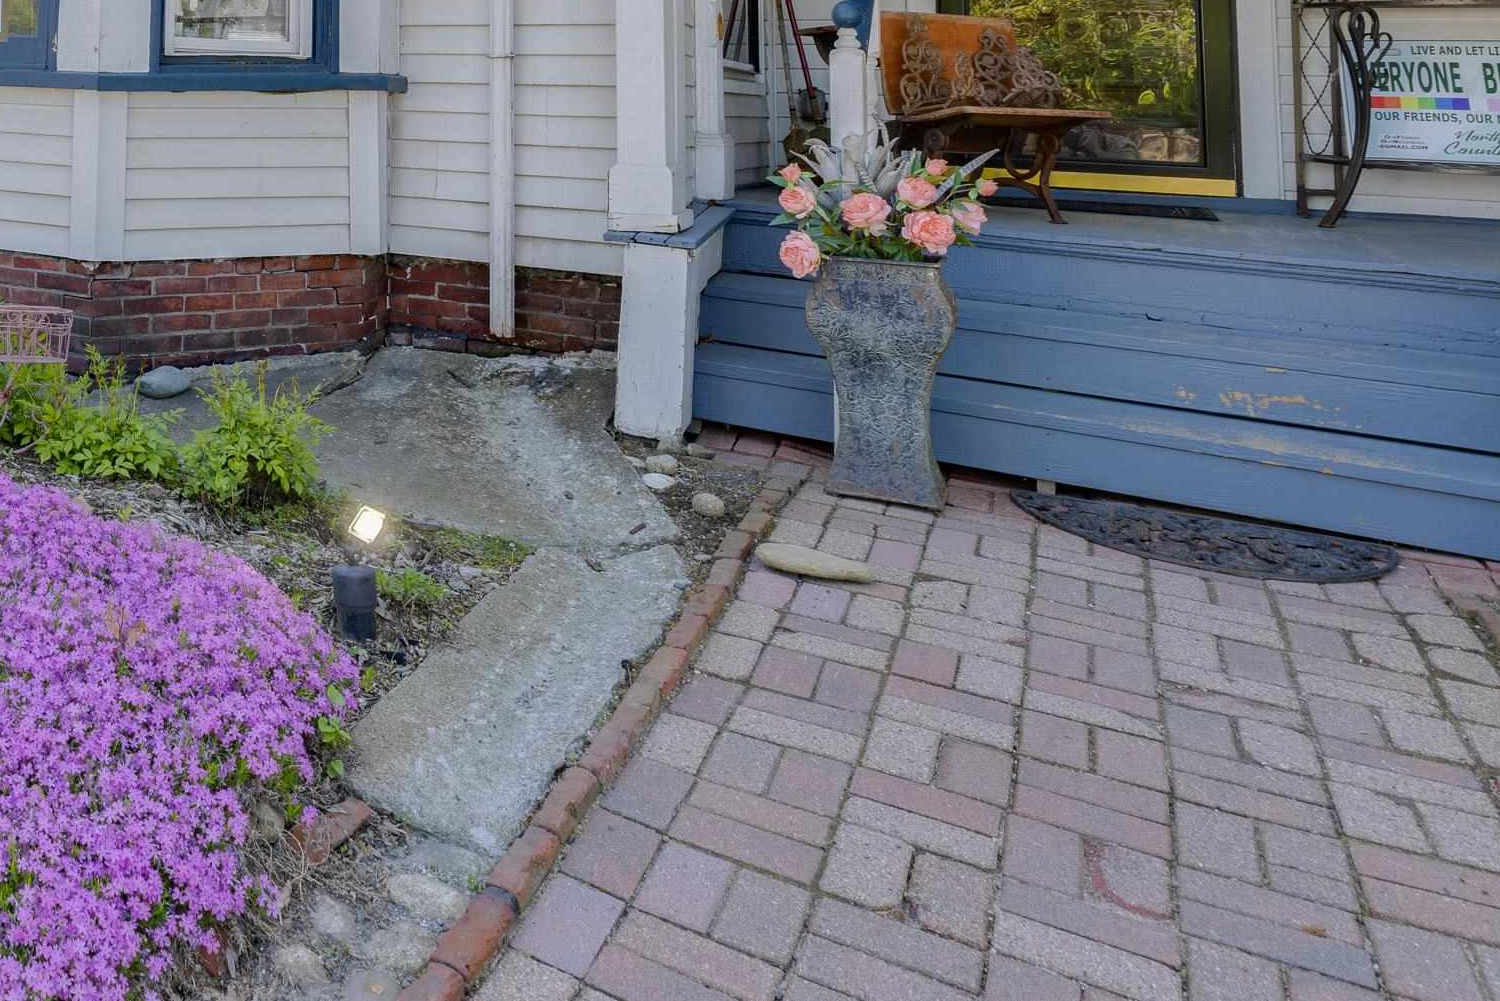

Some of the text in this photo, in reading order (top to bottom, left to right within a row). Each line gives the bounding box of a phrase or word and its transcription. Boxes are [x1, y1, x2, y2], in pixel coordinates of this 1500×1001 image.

[1410, 45, 1436, 55] LIVE
[1439, 46, 1462, 55] AND
[1465, 46, 1485, 56] LET
[1353, 61, 1500, 94] ERYONE B
[1375, 112, 1400, 121] OUR
[1404, 112, 1462, 125] FRIENDS,
[1466, 113, 1492, 123] OUR
